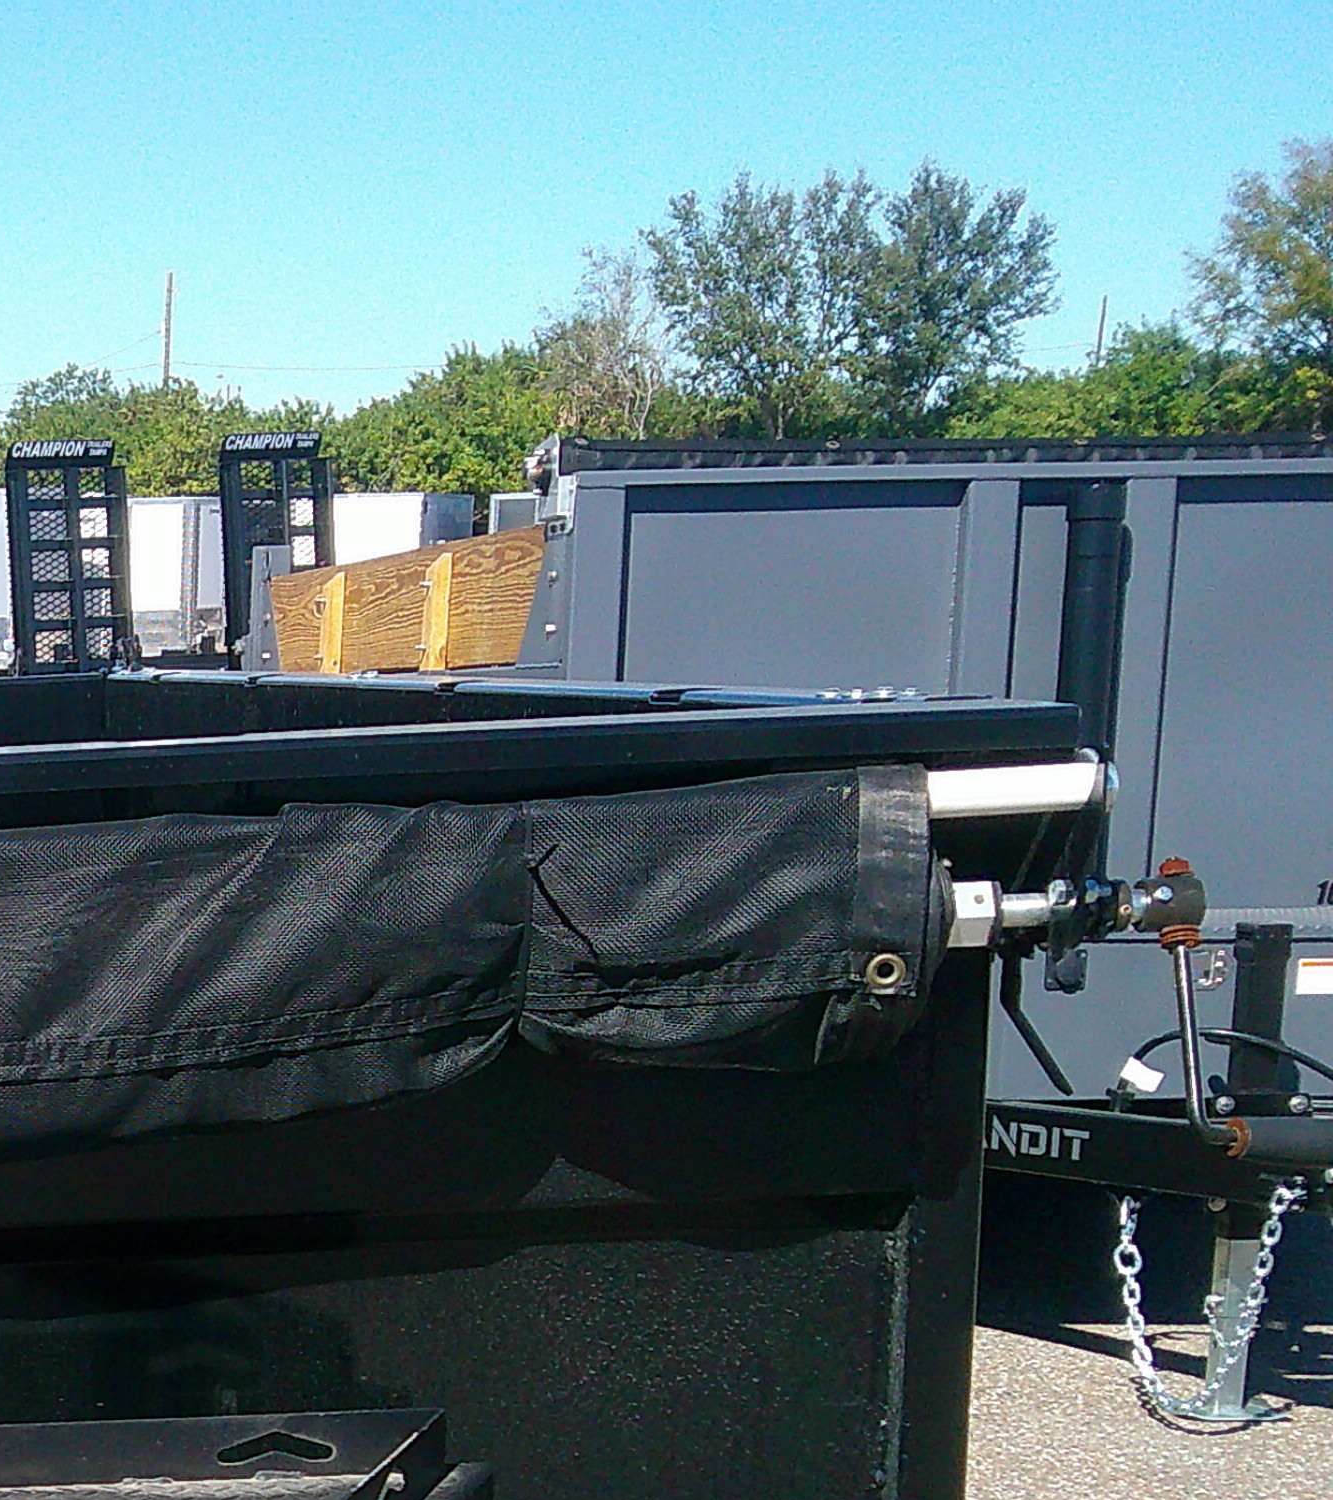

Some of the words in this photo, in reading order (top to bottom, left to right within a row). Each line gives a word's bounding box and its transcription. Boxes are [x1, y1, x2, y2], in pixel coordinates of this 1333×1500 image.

[11, 440, 87, 457] CHAMPION
[224, 433, 295, 450] CHAMPION
[984, 1115, 1091, 1161] NDIT
